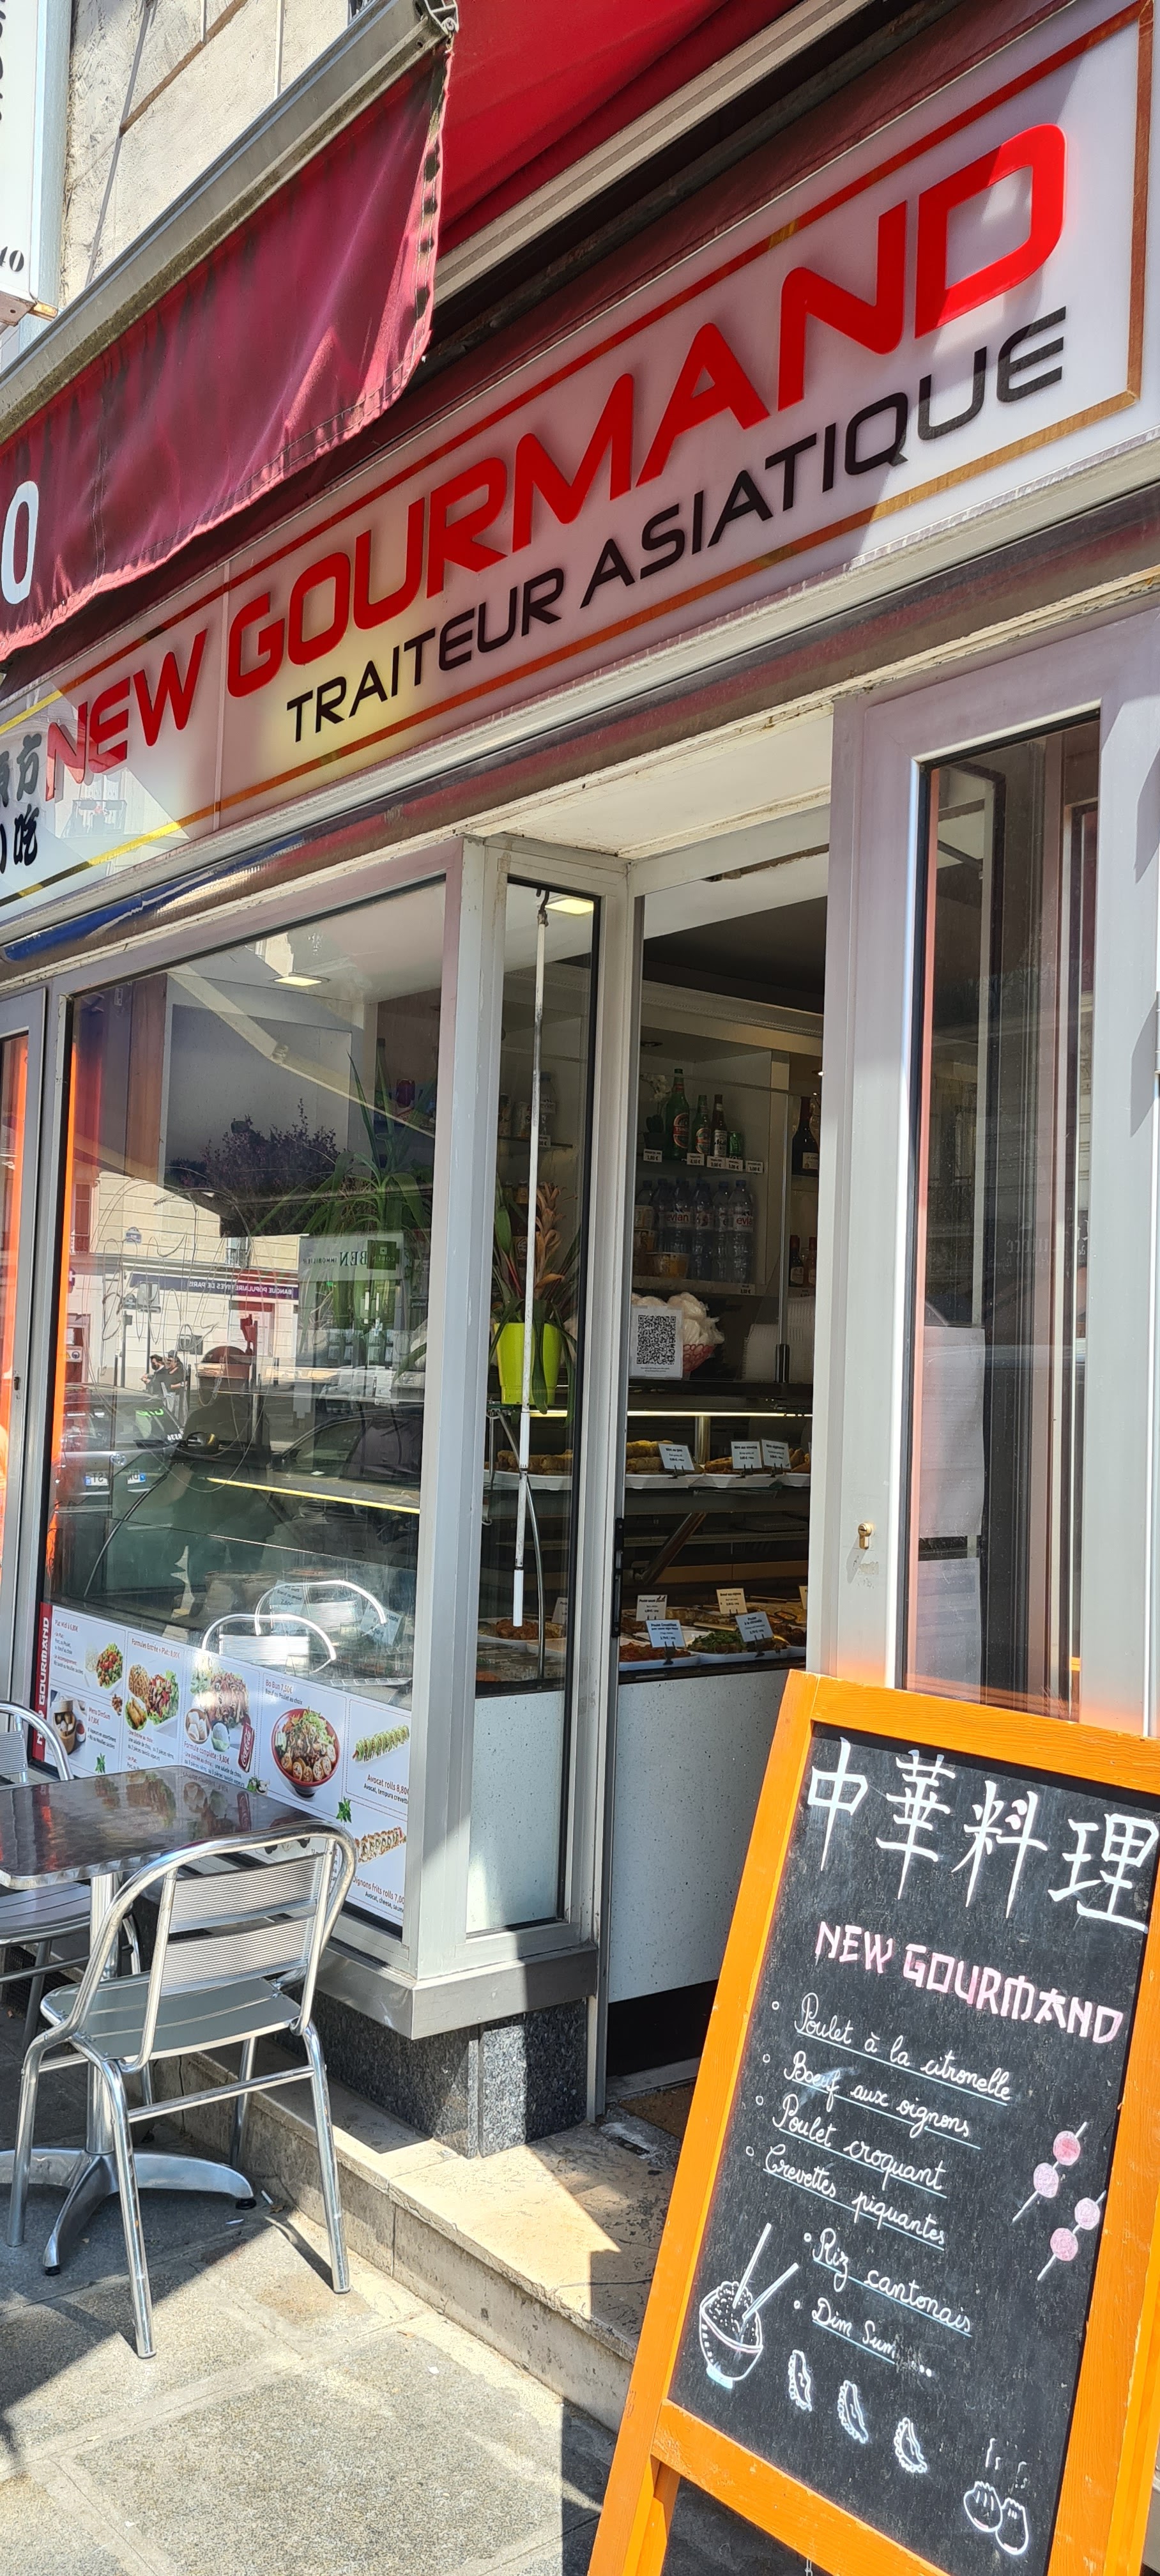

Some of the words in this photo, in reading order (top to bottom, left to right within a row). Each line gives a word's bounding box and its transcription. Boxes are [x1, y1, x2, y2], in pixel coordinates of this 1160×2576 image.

[47, 632, 210, 802] NEW
[228, 123, 1066, 698] GOURMAND
[286, 567, 565, 743] TRAITEUR
[580, 306, 1066, 609] ASIATIQUE
[0, 804, 39, 873] 吃
[736, 1216, 752, 1225] evia
[39, 1617, 49, 1706] GOURMAND
[367, 1774, 384, 1787] Avocat
[385, 1781, 396, 1791] rolls
[807, 1737, 1160, 1934] 中華料理
[372, 1883, 382, 1895] frits
[383, 1889, 393, 1900] rolls
[815, 1920, 894, 1974] NEW
[903, 1943, 1124, 2044] GOURMAND
[784, 2050, 841, 2112] Boeuf
[850, 2084, 889, 2107] aux
[896, 2097, 970, 2139] oignons
[794, 1992, 853, 2044] Poulet
[864, 2032, 880, 2053] à
[890, 2035, 910, 2067] la
[920, 2050, 1011, 2101] citronelle
[772, 2094, 837, 2148] Poulet
[843, 2140, 947, 2191] croquant
[765, 2143, 836, 2198] Crevettes
[851, 2191, 945, 2246] piquantes
[811, 2297, 853, 2338] Dim
[862, 2320, 896, 2359] Sum
[812, 2227, 849, 2292] Riz
[864, 2270, 971, 2333] cantonais
